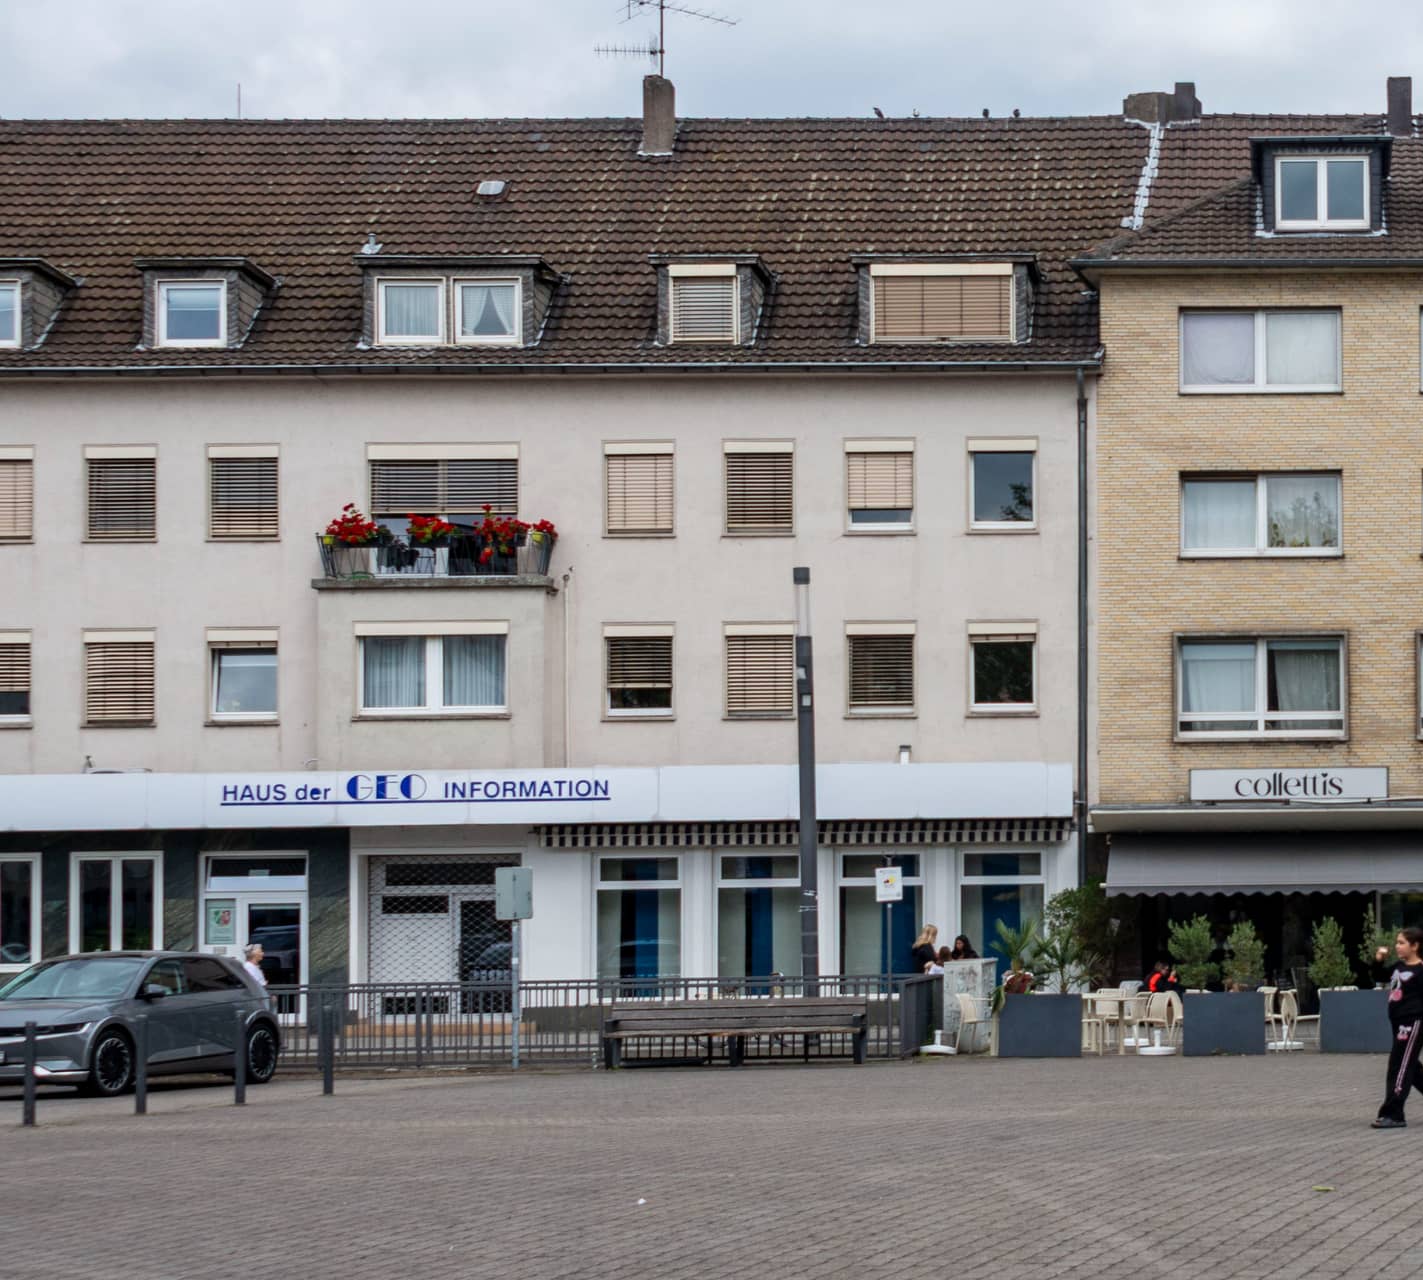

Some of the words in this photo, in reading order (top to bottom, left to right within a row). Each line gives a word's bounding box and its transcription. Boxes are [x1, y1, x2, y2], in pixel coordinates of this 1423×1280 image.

[222, 783, 287, 802] HAUS
[294, 784, 331, 801] der
[346, 773, 427, 801] GEO
[443, 779, 610, 799] INFORMATION
[1234, 771, 1343, 797] collettis
